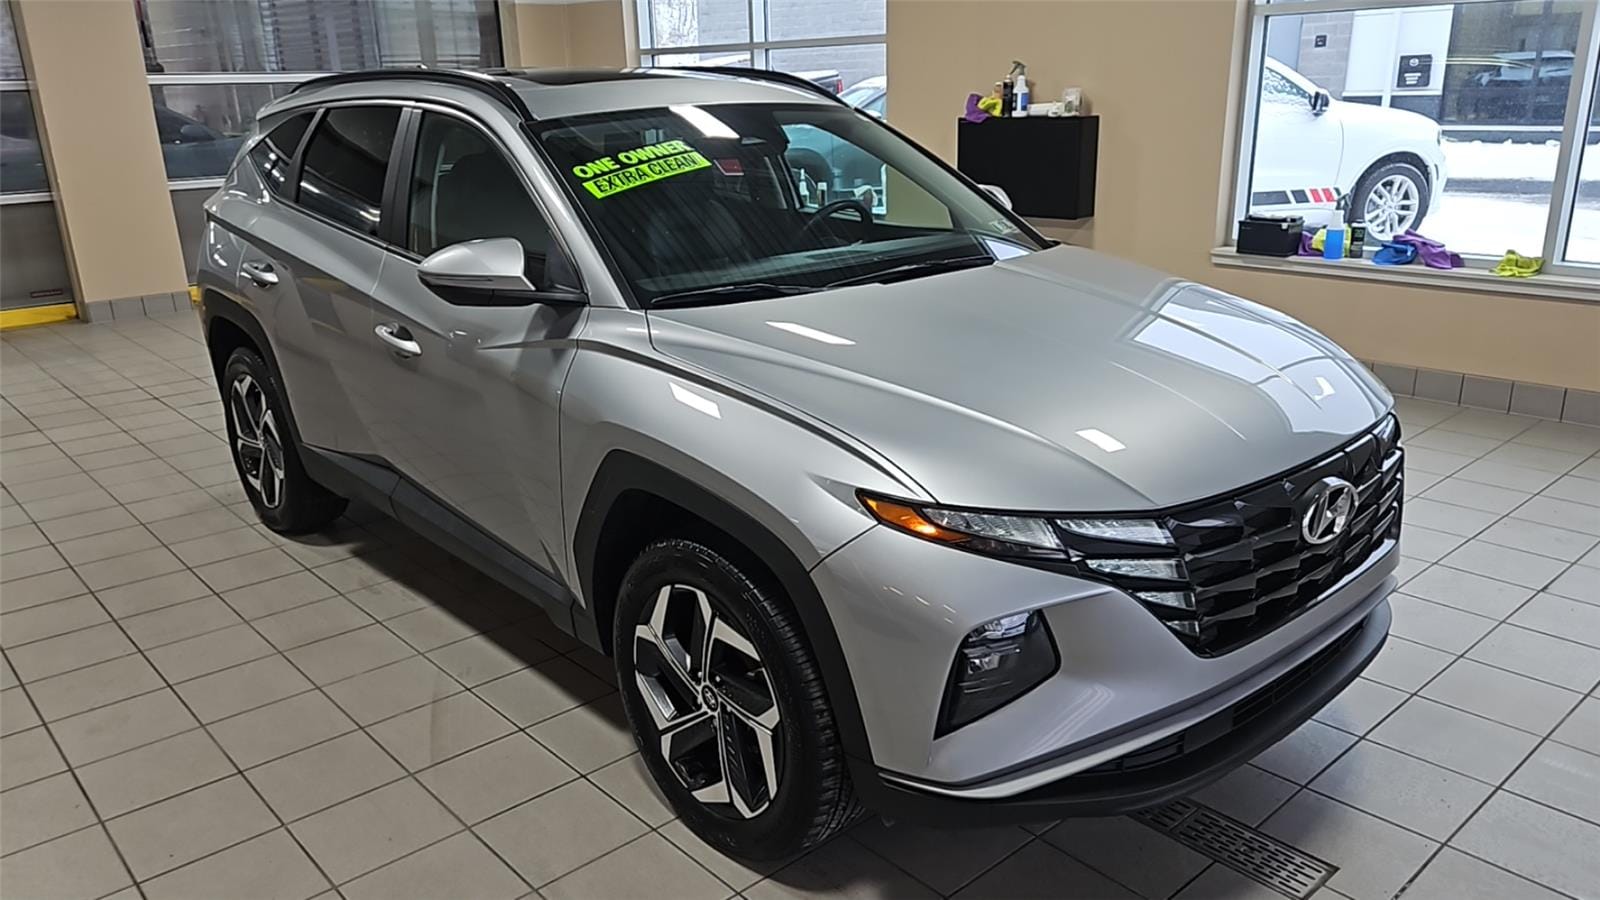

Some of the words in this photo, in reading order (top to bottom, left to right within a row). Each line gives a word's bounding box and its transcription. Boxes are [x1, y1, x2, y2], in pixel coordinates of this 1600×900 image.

[573, 157, 620, 178] ONE
[618, 139, 695, 164] OWNER
[593, 168, 647, 193] EXTRA
[648, 154, 698, 176] CLEAN
